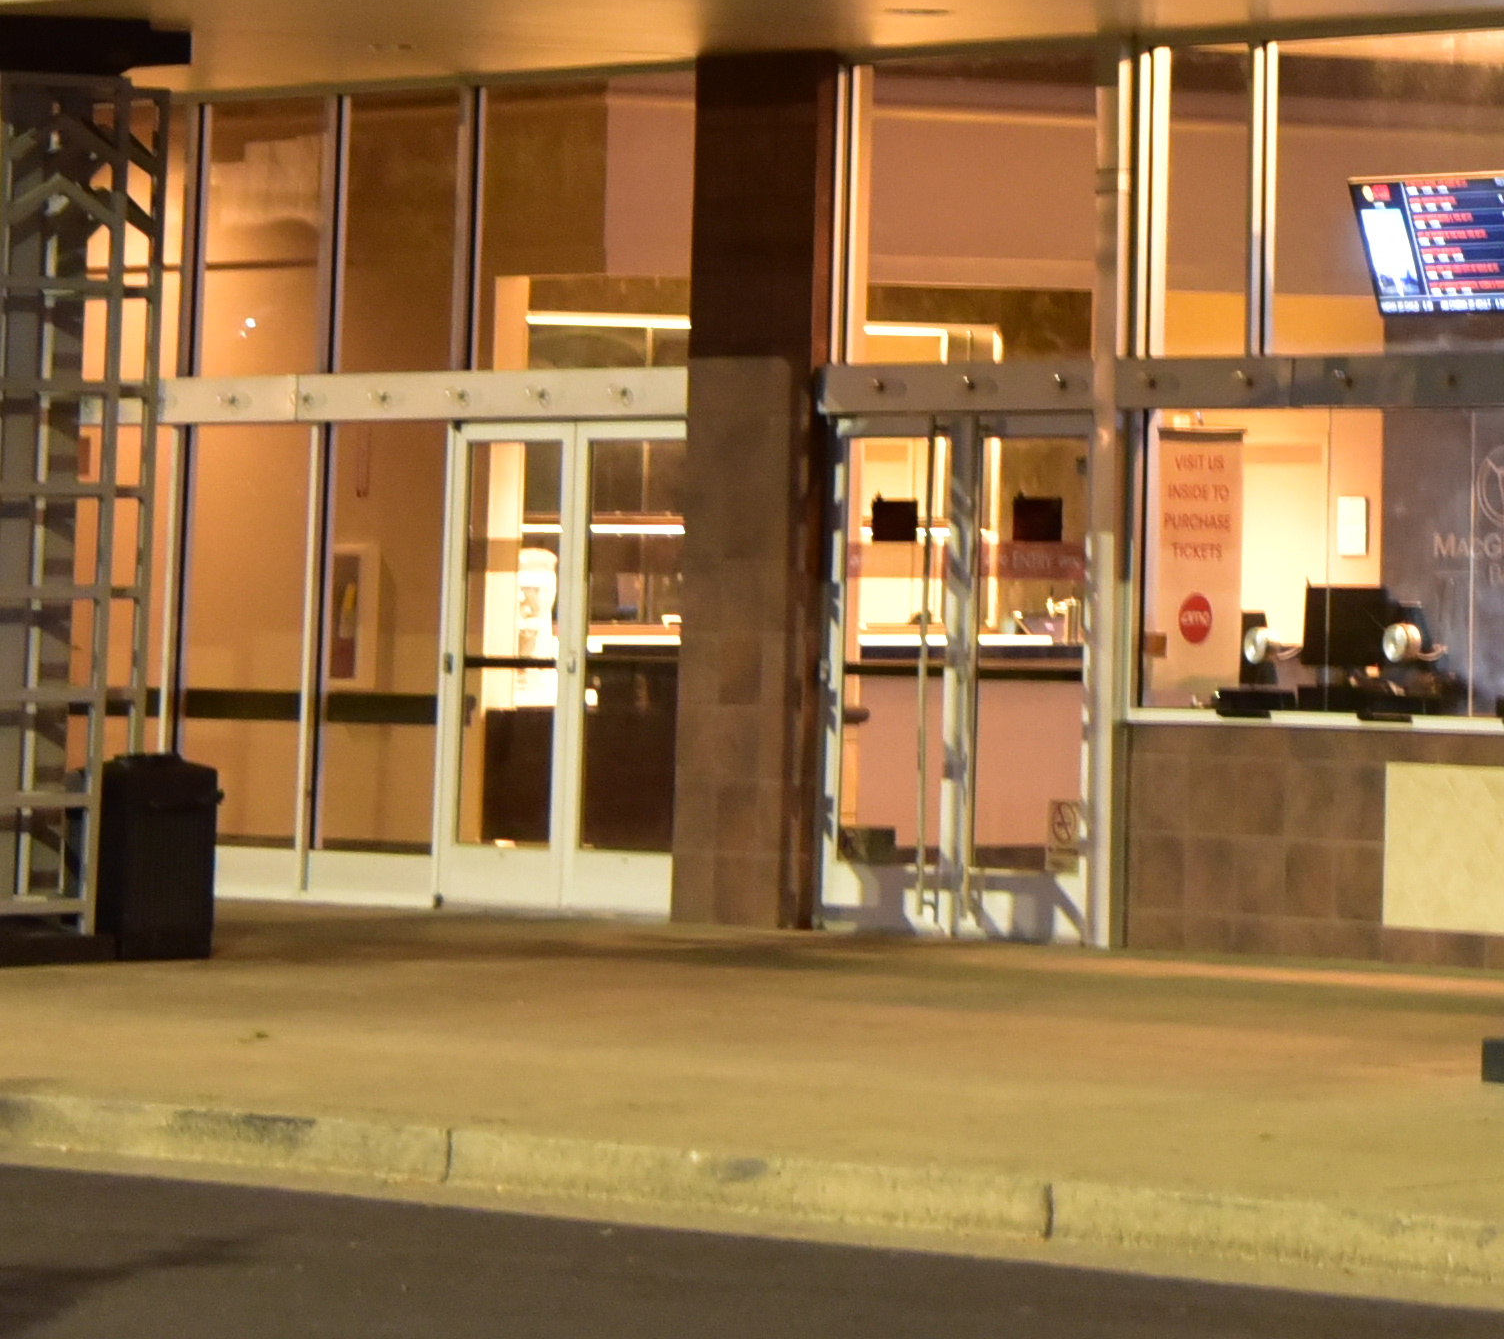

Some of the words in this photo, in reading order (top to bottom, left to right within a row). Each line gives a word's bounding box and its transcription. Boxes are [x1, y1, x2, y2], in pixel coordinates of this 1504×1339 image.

[1175, 454, 1204, 471] VISIT
[1208, 454, 1225, 471] US
[1168, 483, 1208, 502] INSIDE
[1211, 483, 1230, 502] TO
[1163, 512, 1232, 533] PURCHASE
[1171, 542, 1224, 562] TICKETS
